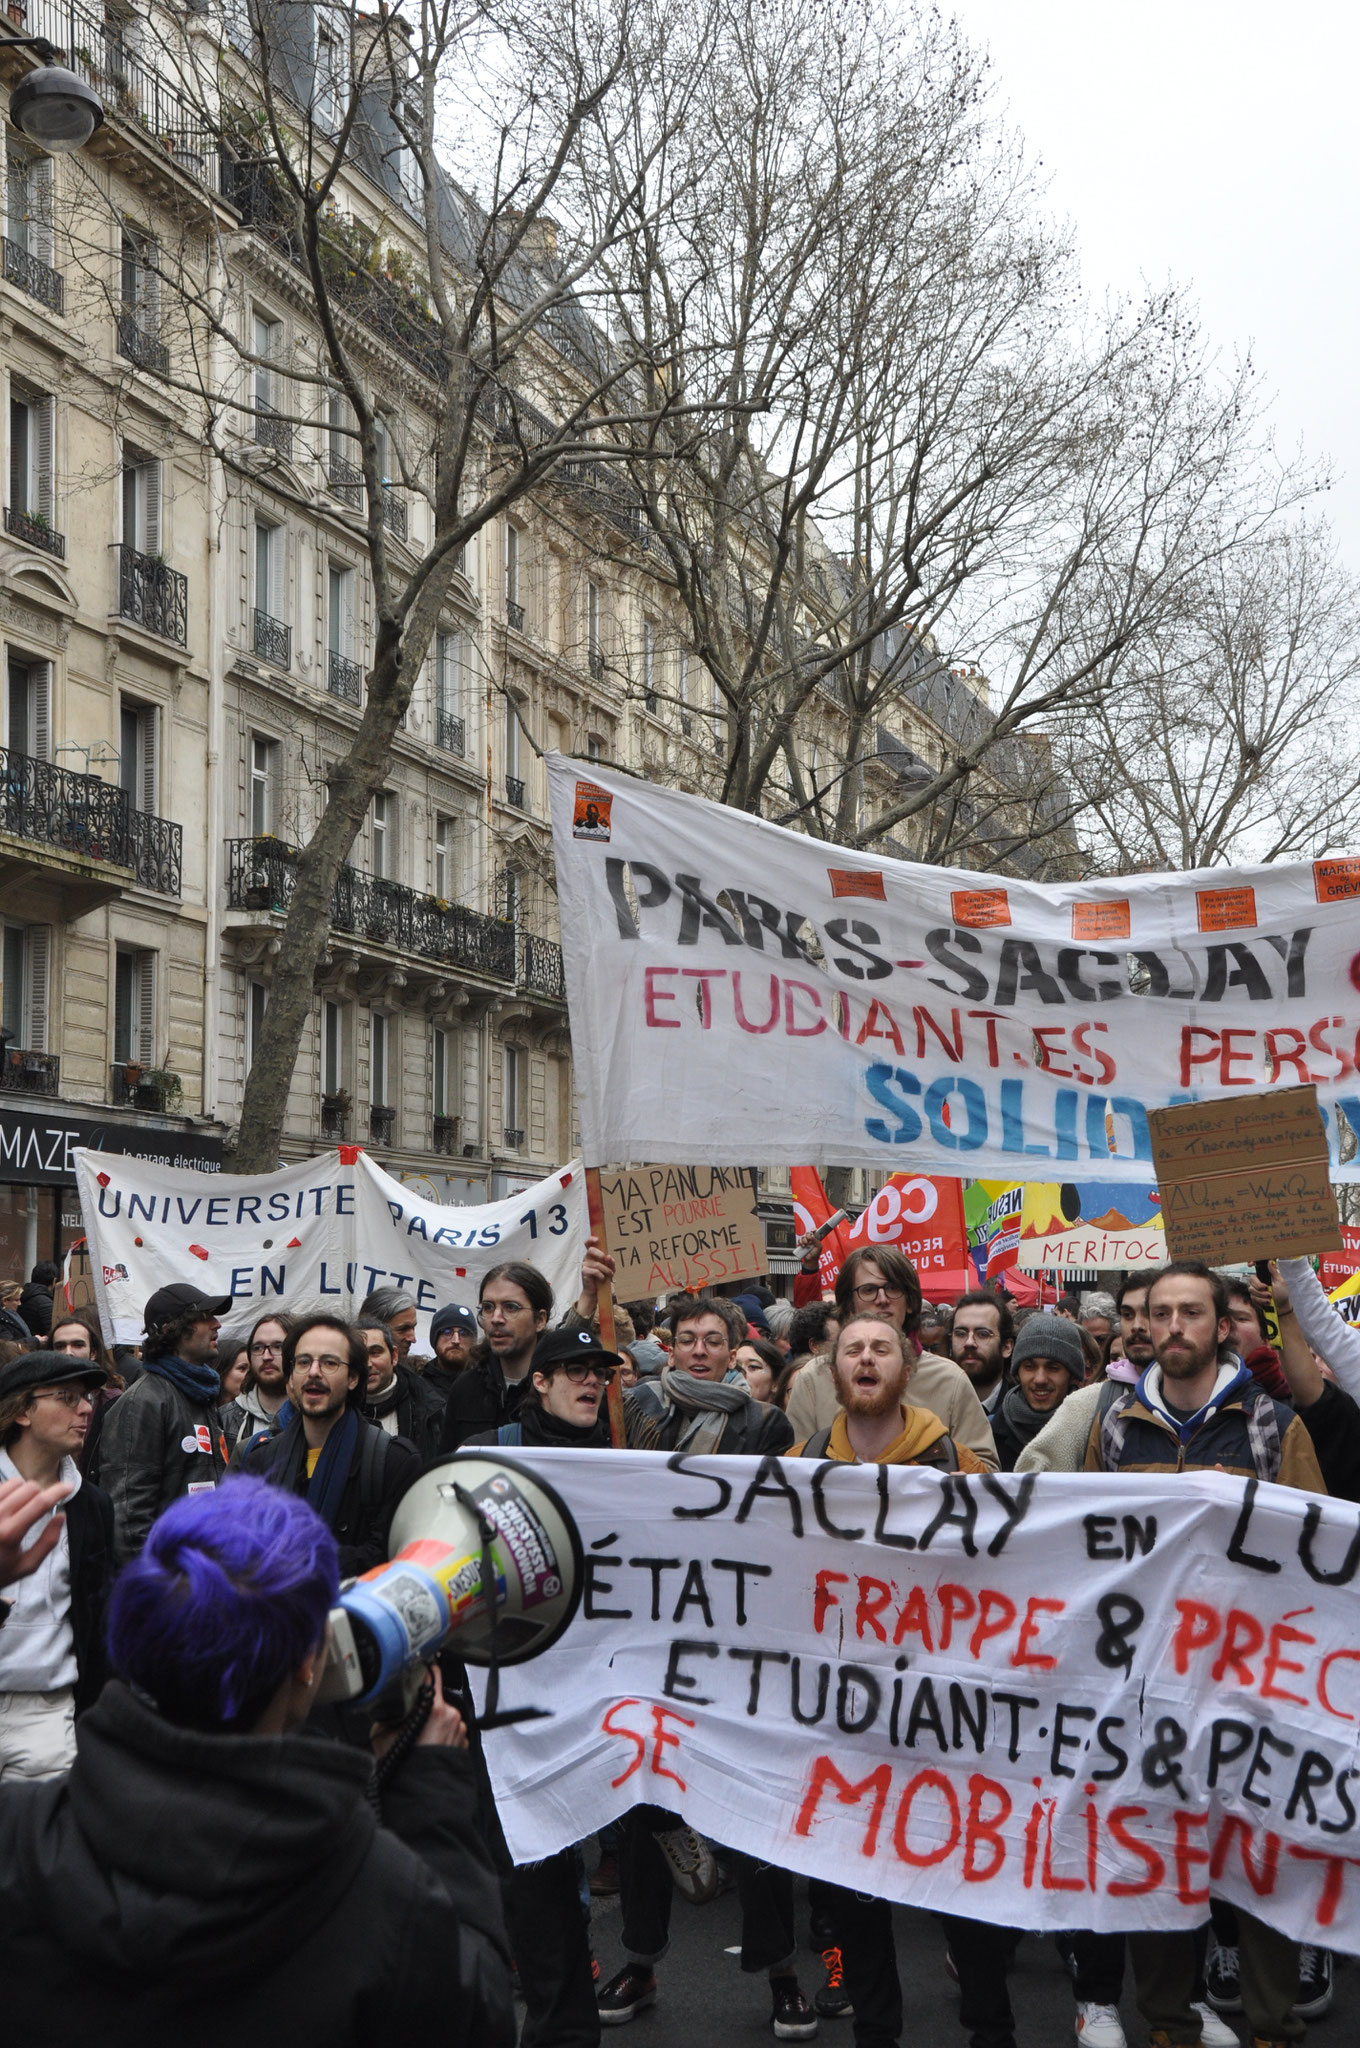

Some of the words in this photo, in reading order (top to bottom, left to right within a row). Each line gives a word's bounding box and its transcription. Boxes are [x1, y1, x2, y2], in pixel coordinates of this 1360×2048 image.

[1327, 881, 1360, 896] GRÈV
[98, 1184, 354, 1225] UNIVERSITE
[387, 1200, 500, 1248] PARIS
[601, 1177, 647, 1211] MA
[617, 1209, 653, 1237] EST
[663, 1195, 727, 1227] POURRIE
[614, 1246, 641, 1268] TA
[650, 1223, 742, 1263] REFORME
[648, 1246, 748, 1291] AUSSI
[230, 1264, 286, 1297] EN
[321, 1261, 438, 1313] LUTTE
[667, 1452, 1041, 1557] SACLAY
[1083, 1513, 1158, 1561] EN
[813, 1569, 1066, 1669] FRAPPE
[1095, 1592, 1145, 1678] &
[602, 1697, 696, 1793] SE
[1206, 1717, 1360, 1834] PERS
